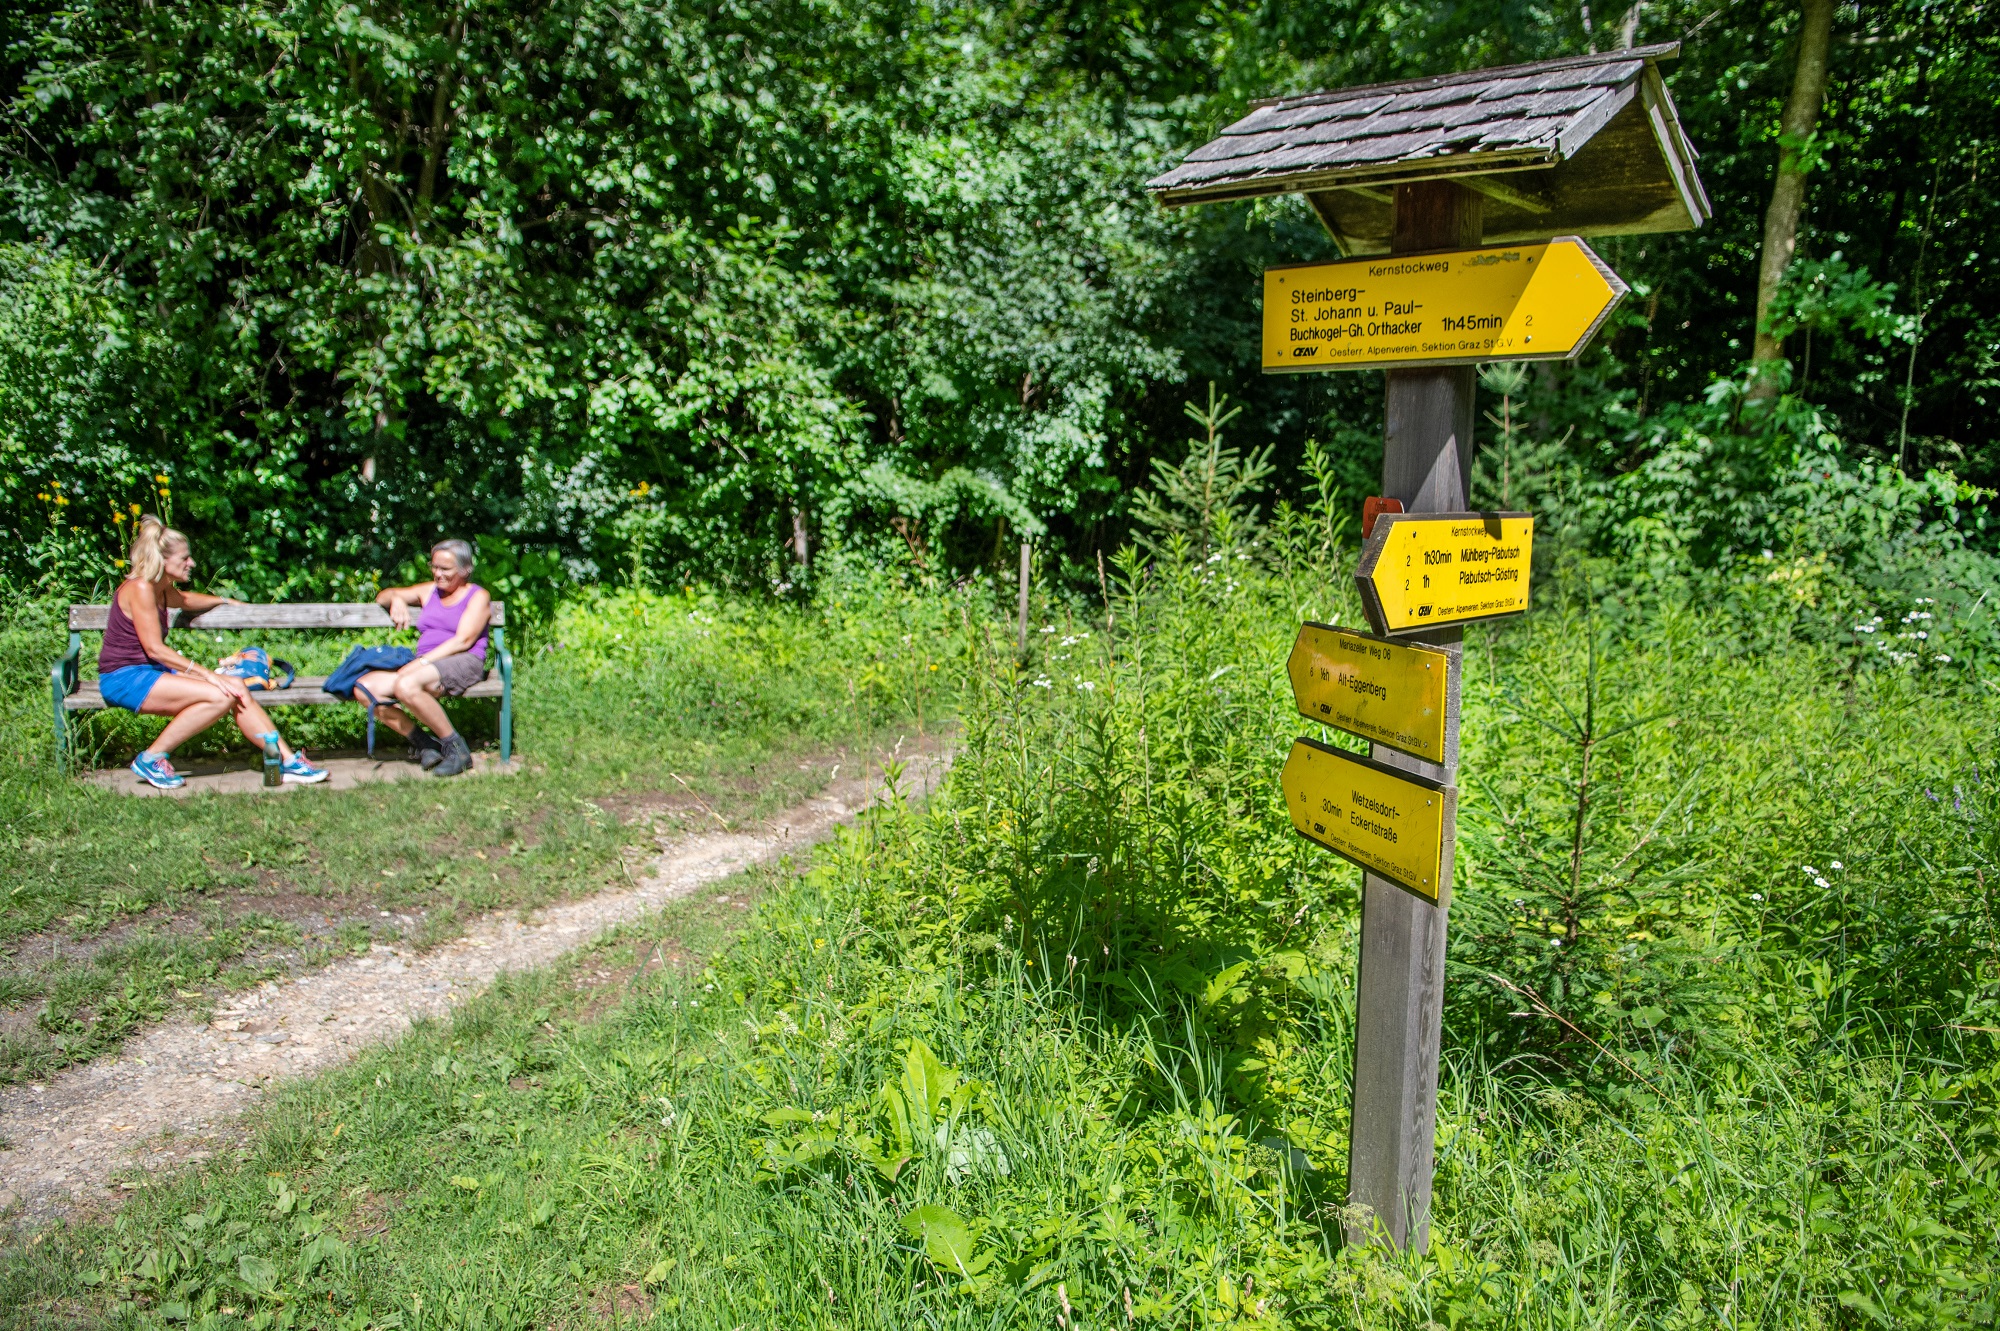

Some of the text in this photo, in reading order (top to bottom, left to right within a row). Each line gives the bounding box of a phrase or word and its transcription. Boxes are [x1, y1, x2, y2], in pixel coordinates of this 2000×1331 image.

[1368, 260, 1449, 277] Kernstockweg
[1291, 287, 1367, 305] Steinberg-
[1290, 300, 1423, 324] St. Johann u. Paul-
[1524, 315, 1533, 327] 2
[1290, 320, 1422, 342] Buchkogel-Gh. Orthacker
[1441, 315, 1503, 332] 1h45min
[1330, 346, 1364, 357] Oesterr.
[1422, 341, 1456, 352] Sektion
[1458, 340, 1480, 350] Graz
[1451, 525, 1488, 538] Kernstockweg
[1406, 546, 1520, 567] 2 1h30min Mühlberg-Plabutsch
[1405, 567, 1519, 591] 2 1h Plabutsch-Gösting
[1339, 638, 1367, 654] Mariazeller
[1369, 645, 1382, 660] Weg
[1338, 672, 1387, 701] Alt-Eggenberg
[1323, 799, 1343, 819] 30min
[1351, 789, 1401, 820] Wetzelsdorf-
[1350, 811, 1398, 844] Eckertstraße
